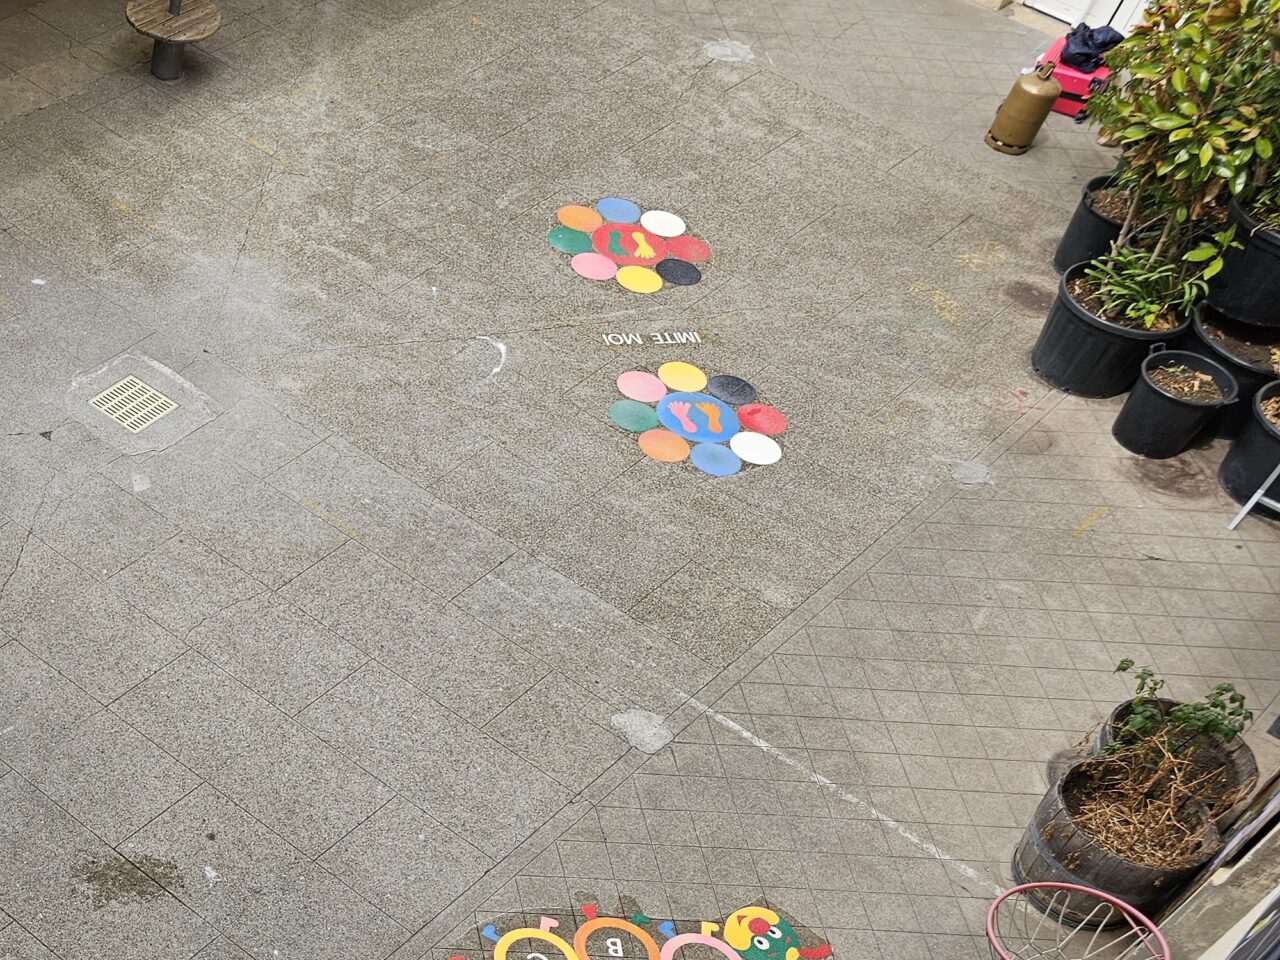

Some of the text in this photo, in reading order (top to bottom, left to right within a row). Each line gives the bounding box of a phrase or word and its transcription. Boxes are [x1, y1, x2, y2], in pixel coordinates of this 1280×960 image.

[601, 331, 702, 346] IMITE MOI
[605, 937, 624, 957] B
